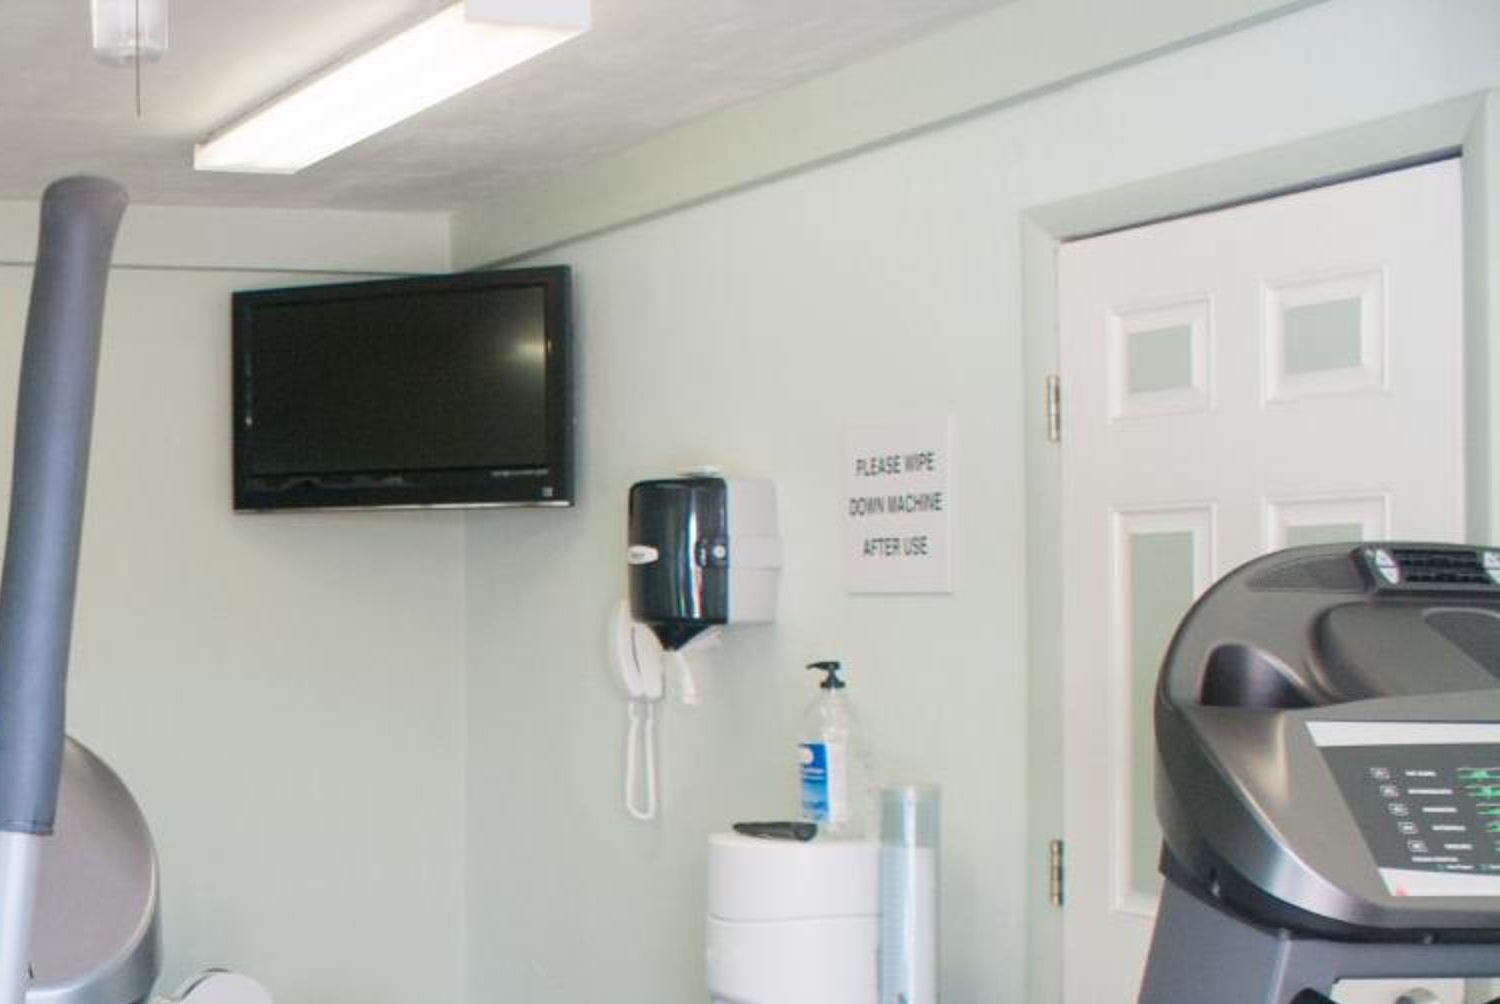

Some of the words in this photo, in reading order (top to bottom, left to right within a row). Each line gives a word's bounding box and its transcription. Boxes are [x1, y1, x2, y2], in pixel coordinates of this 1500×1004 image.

[855, 454, 901, 477] PLEASE
[903, 451, 936, 474] WIPE
[848, 496, 885, 517] DOWN
[887, 491, 943, 514] MACHINE
[863, 537, 901, 557] AFTER
[903, 535, 929, 556] USE
